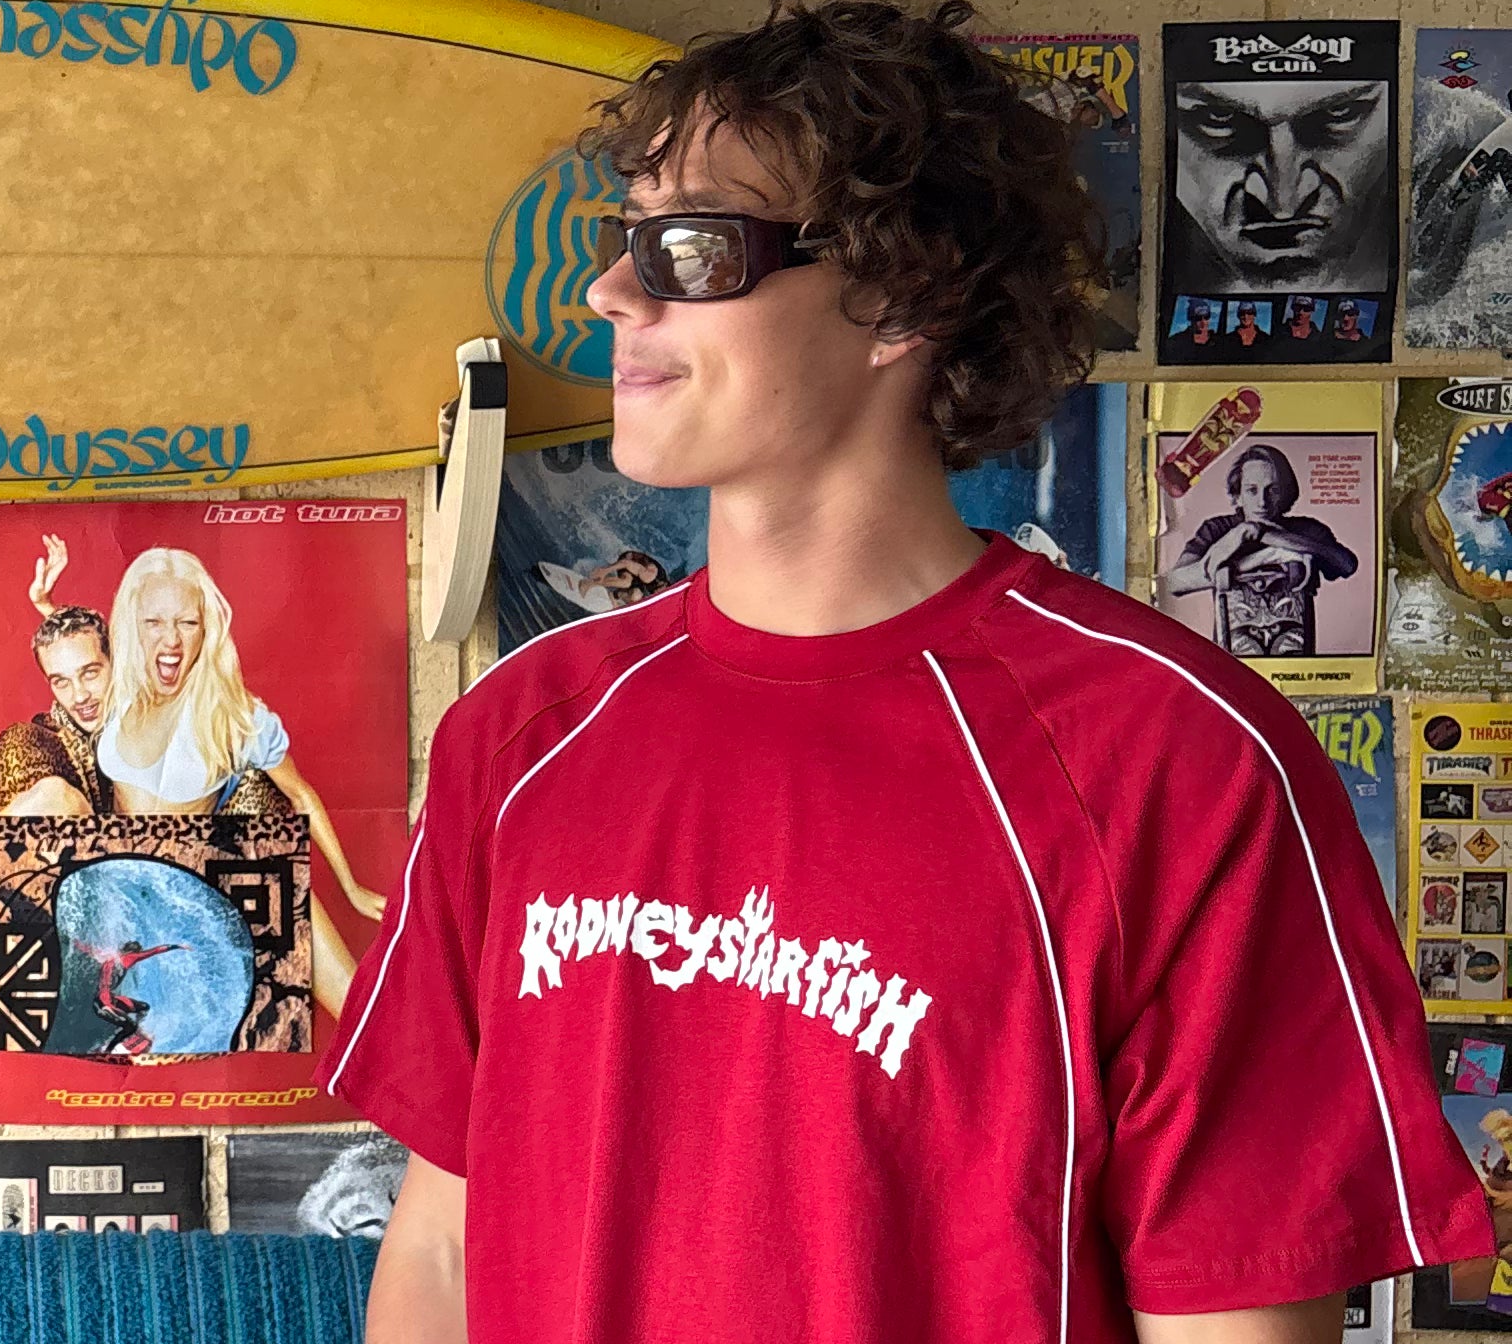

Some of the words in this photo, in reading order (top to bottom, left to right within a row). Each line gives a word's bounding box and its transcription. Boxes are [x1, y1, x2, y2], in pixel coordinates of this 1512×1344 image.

[990, 44, 1135, 114] SHER
[1452, 388, 1496, 410] SURF
[203, 503, 285, 524] hot
[297, 503, 402, 524] tuna
[53, 1169, 119, 1192] DECKS
